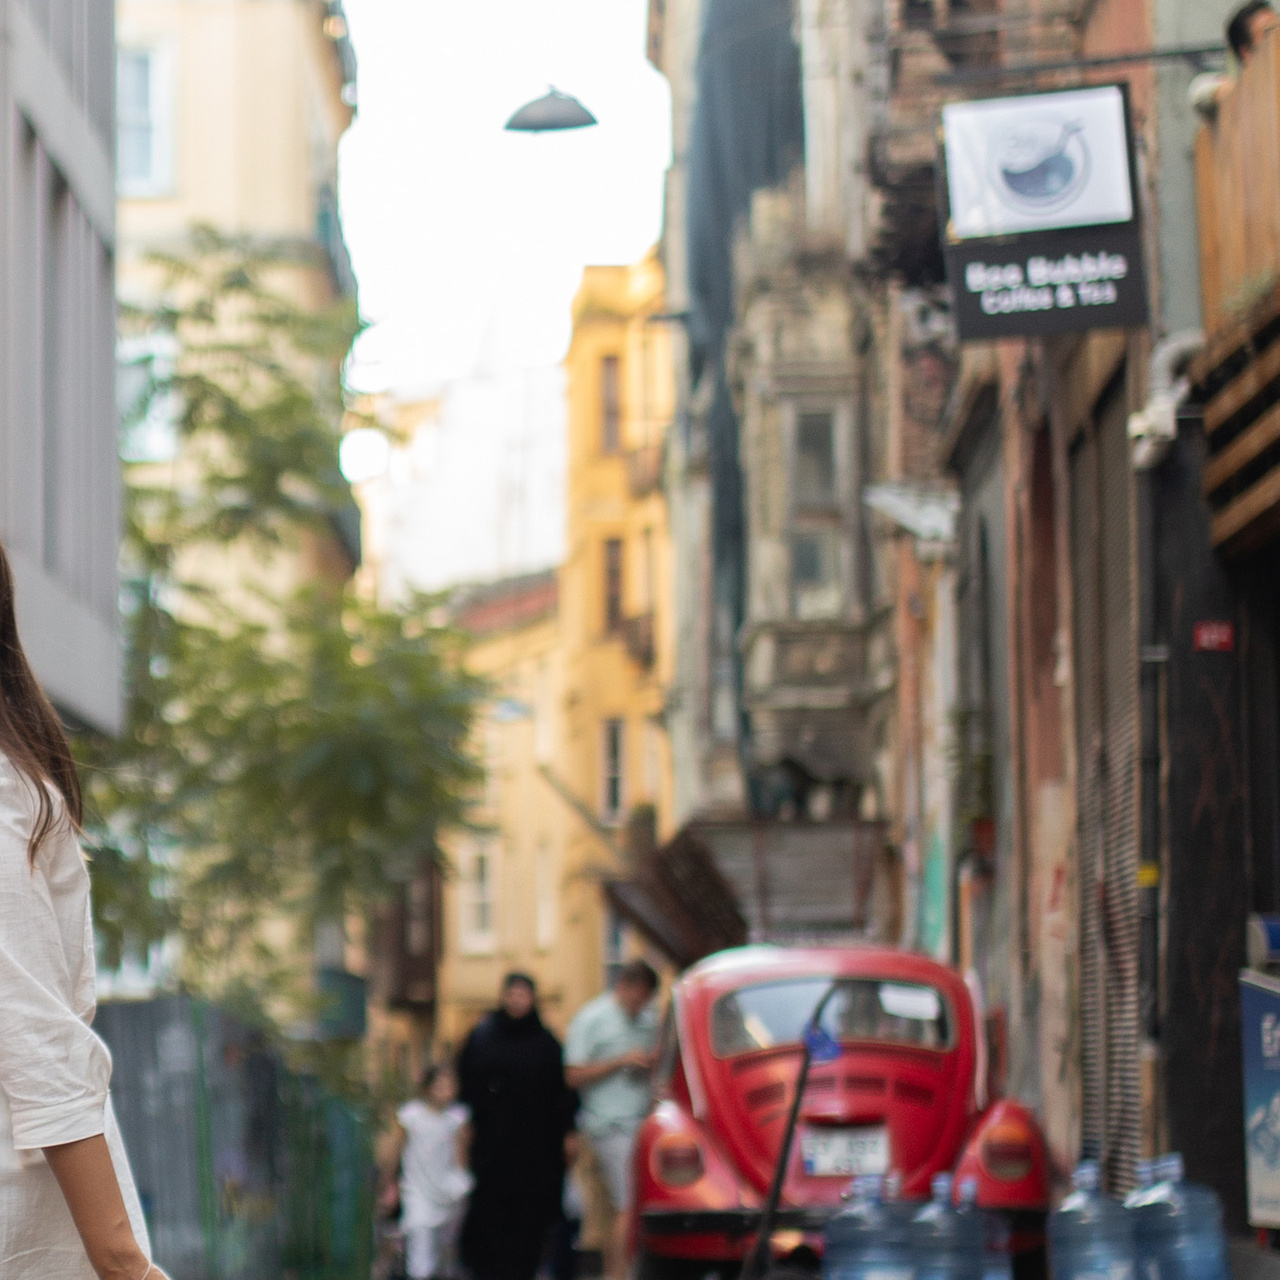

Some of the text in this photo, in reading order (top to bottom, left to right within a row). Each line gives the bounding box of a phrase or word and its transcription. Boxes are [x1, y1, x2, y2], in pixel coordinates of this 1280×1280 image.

[1027, 251, 1127, 287] Bubble
[981, 285, 1053, 314] Coffee
[1078, 281, 1117, 305] Tea
